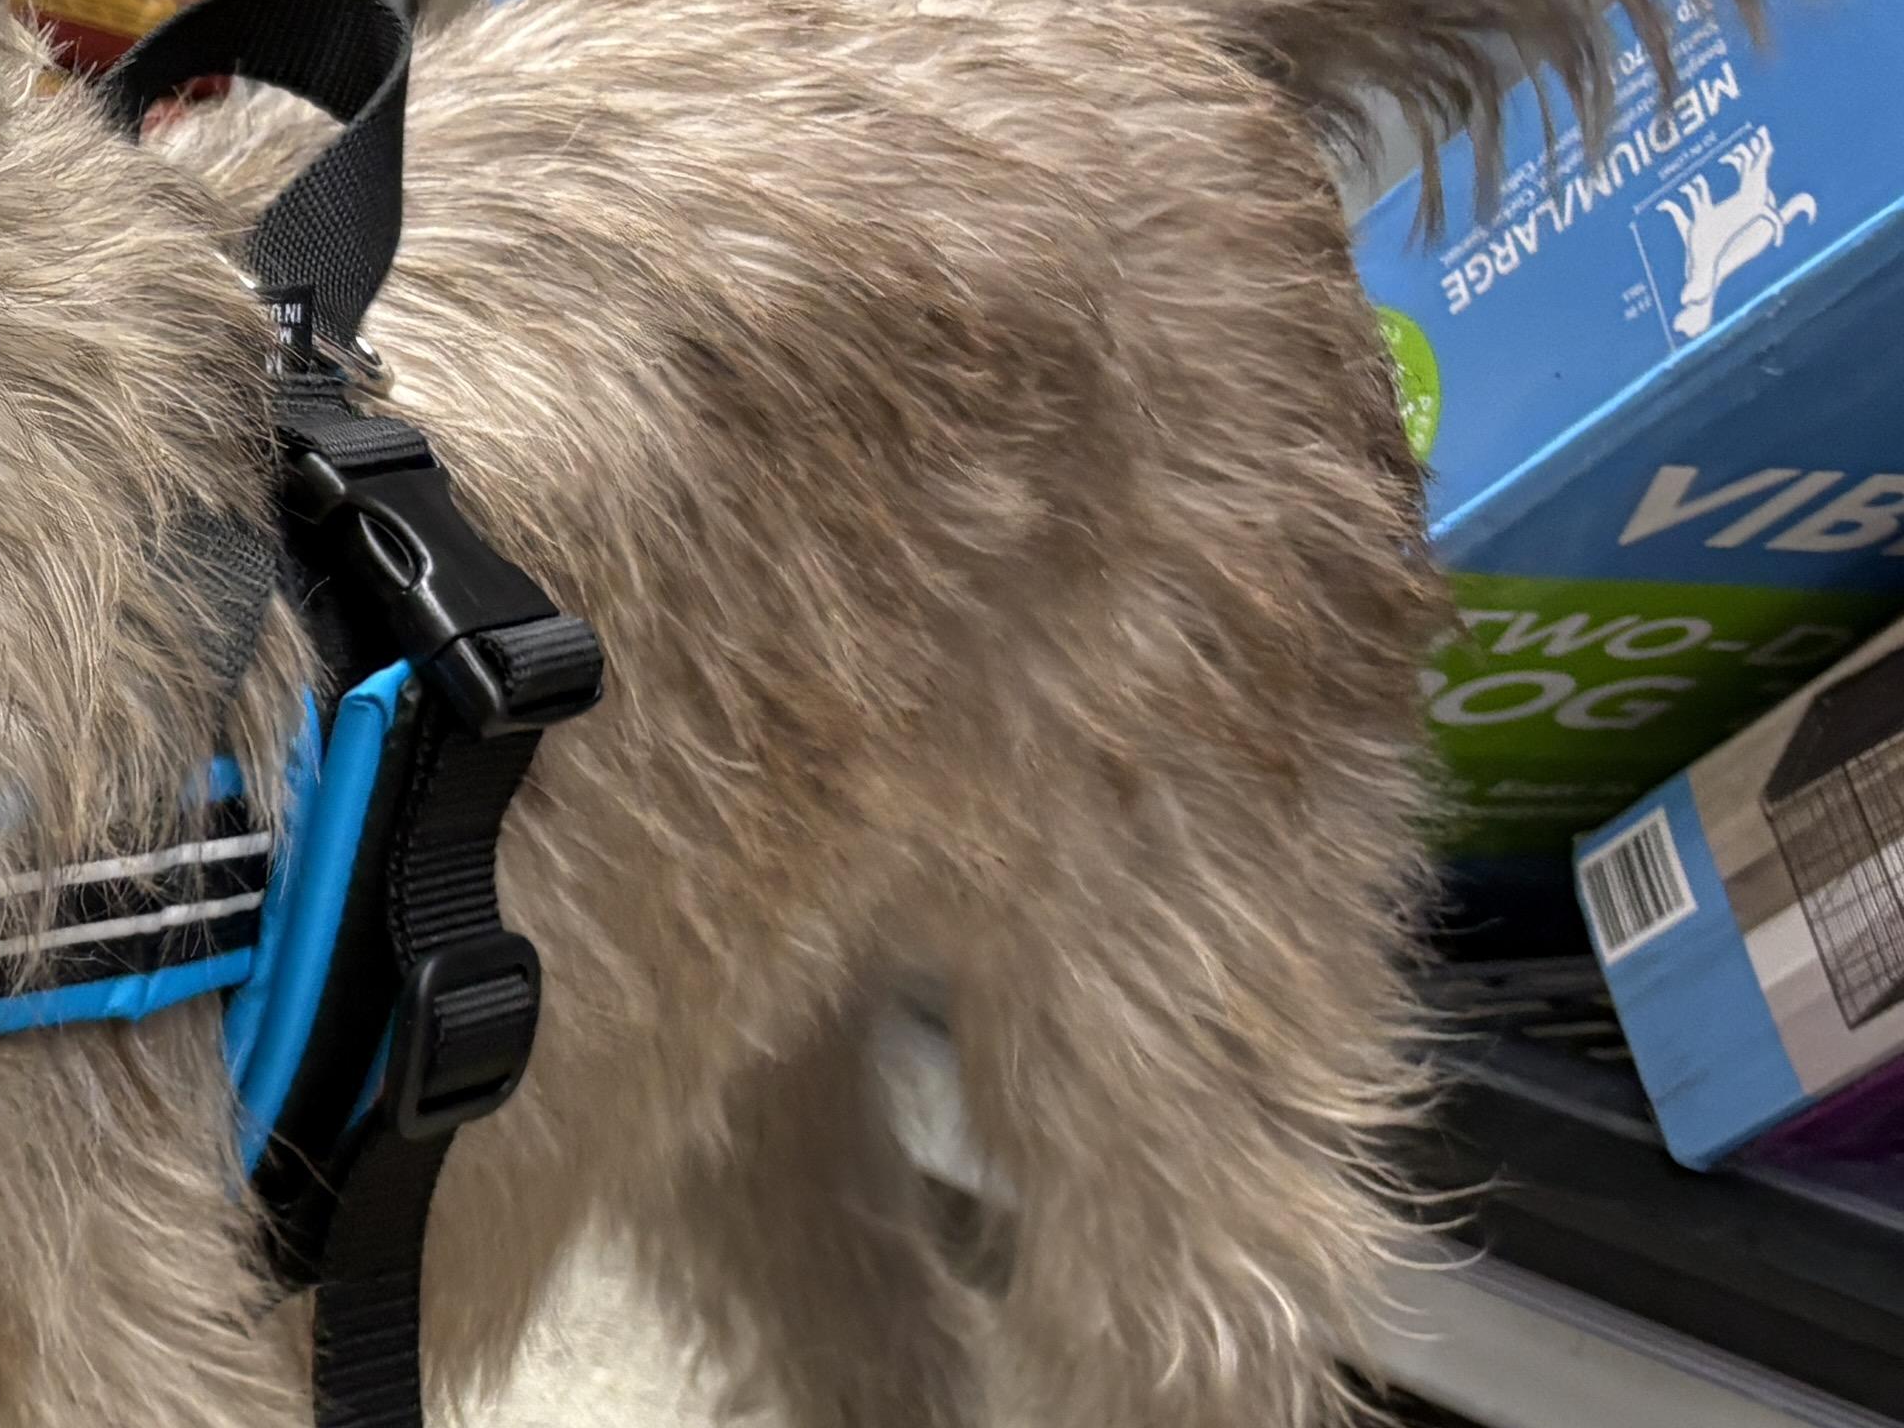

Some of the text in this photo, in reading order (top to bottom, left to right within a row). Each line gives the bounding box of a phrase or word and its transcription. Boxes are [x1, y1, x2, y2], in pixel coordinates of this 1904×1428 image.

[1439, 61, 1742, 315] MEDIUM/LARGE
[1618, 464, 1904, 558] VIB
[1430, 609, 1854, 668] TWO-D
[1418, 668, 1698, 731] OG
